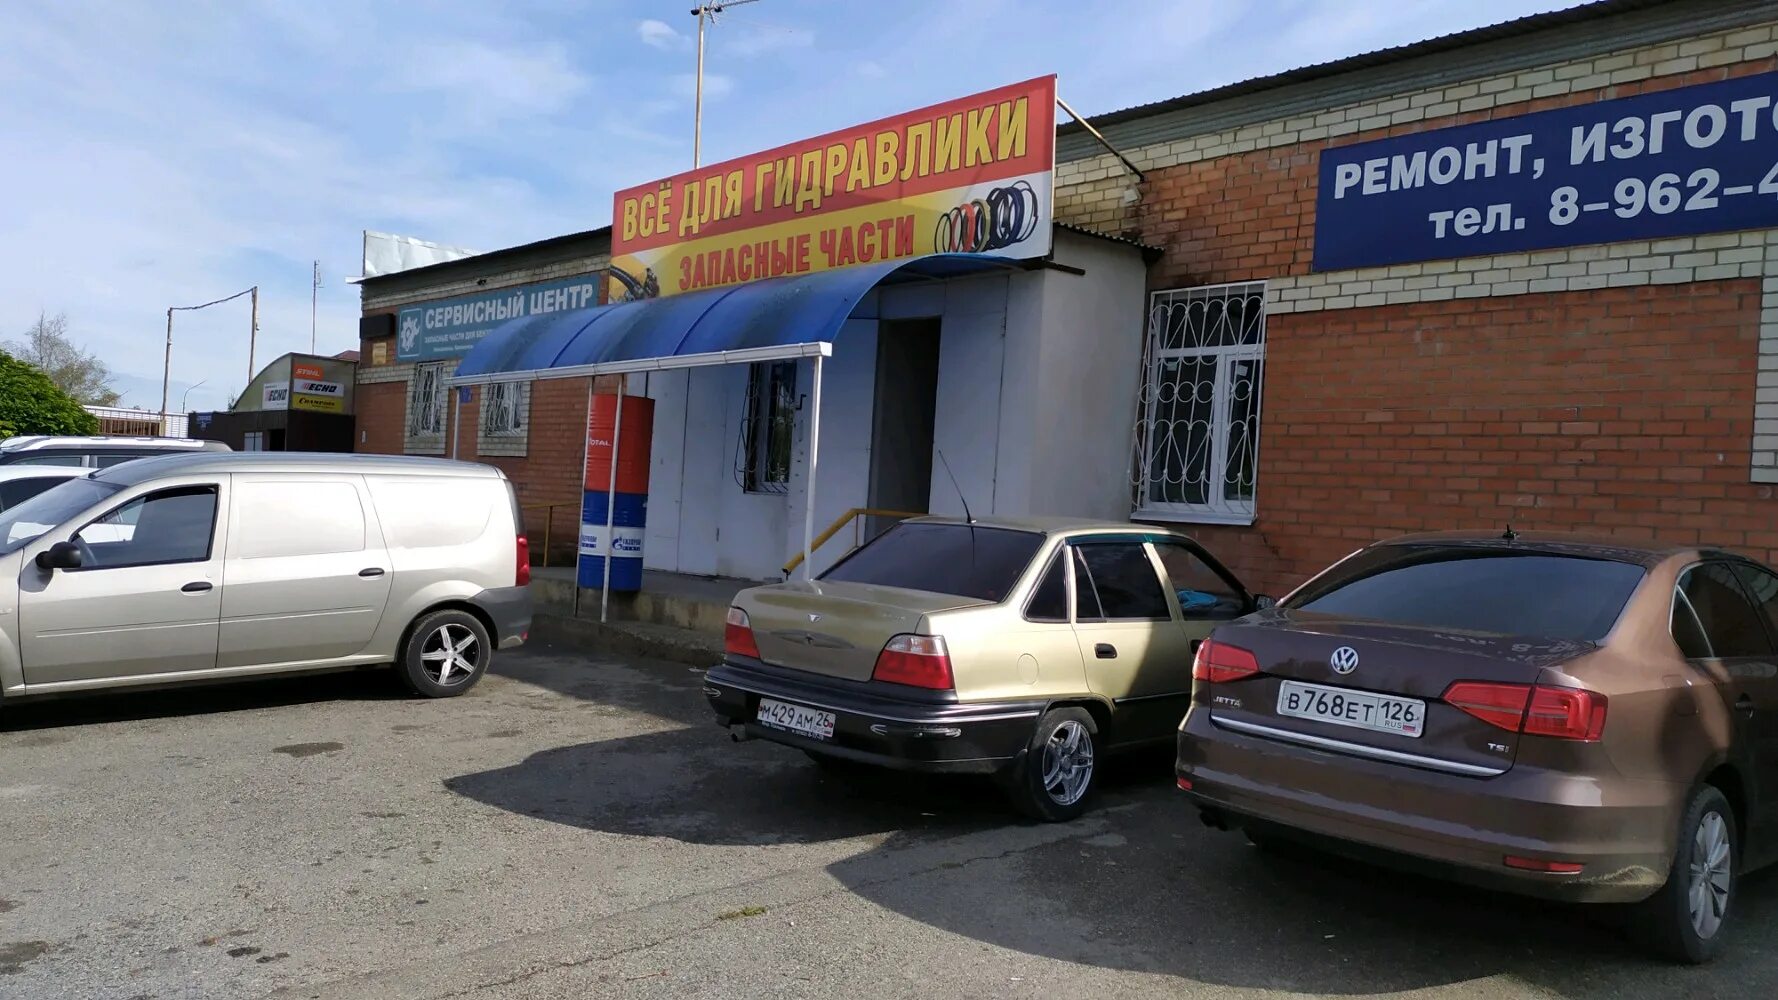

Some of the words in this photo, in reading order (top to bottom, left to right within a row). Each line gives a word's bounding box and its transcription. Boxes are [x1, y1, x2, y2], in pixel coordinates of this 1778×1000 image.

[1334, 133, 1545, 199] РЕМОНТ,
[1570, 96, 1778, 166] ИЗГОТ
[621, 182, 672, 243] ВСЁ
[678, 169, 744, 237] ДЛЯ
[754, 96, 1029, 213] ГИДРАВЛИКИ
[1428, 202, 1526, 239] тел.
[678, 233, 811, 291] ЗАПАСНЫЕ
[819, 214, 916, 268] ЧАСТИ
[425, 291, 525, 329] СЕРВИСНЫЙ
[530, 283, 593, 314] ЦЕНТР
[268, 388, 288, 402] ECHO
[308, 383, 338, 393] ECHO
[1213, 695, 1241, 708] JETTA
[1381, 700, 1415, 722] 126
